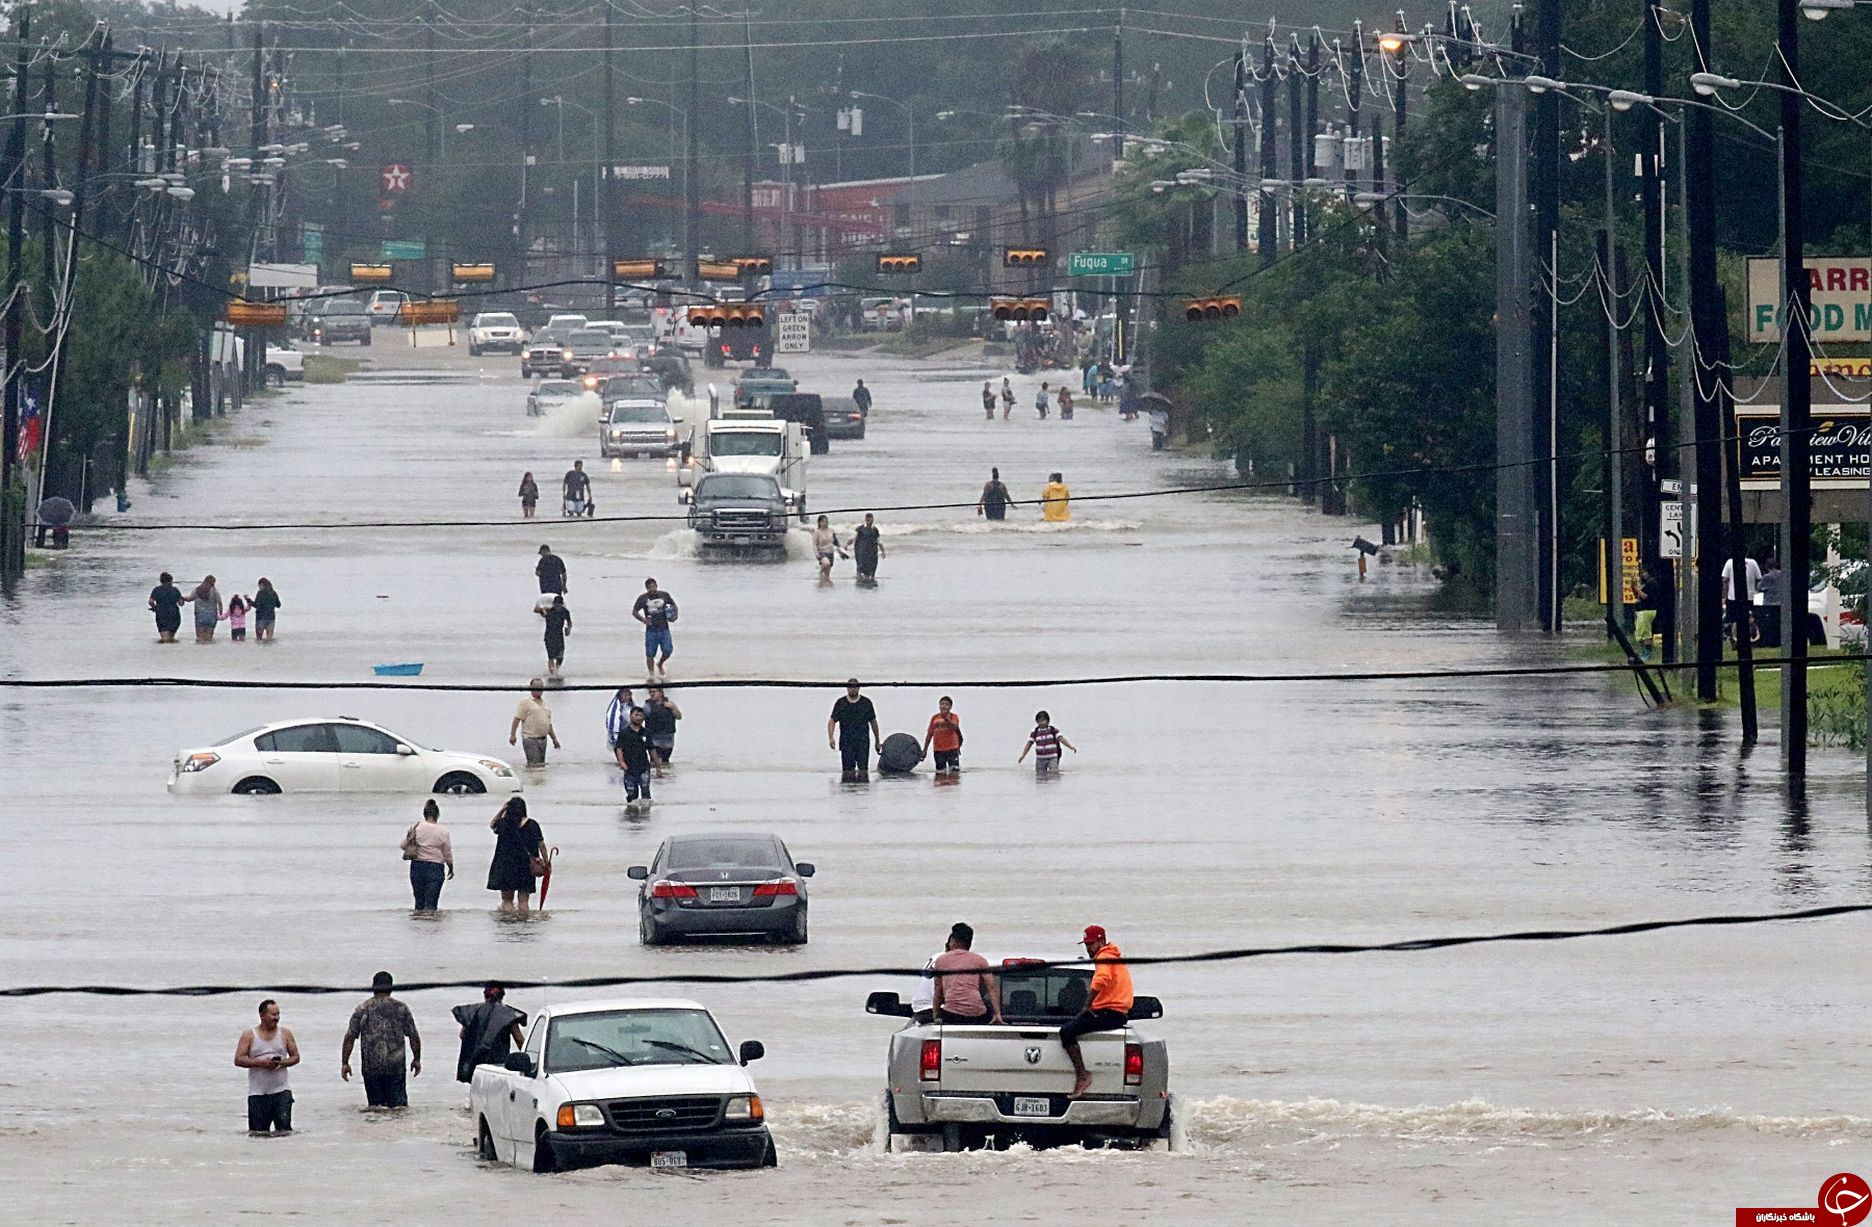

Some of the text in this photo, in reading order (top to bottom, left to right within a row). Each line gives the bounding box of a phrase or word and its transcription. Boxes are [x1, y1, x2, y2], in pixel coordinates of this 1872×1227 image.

[1074, 255, 1107, 270] Fuqua
[798, 315, 808, 323] ON
[783, 324, 806, 332] GREEN
[781, 333, 807, 341] ARROW
[785, 342, 804, 350] ONLY
[1815, 467, 1870, 476] LEASING
